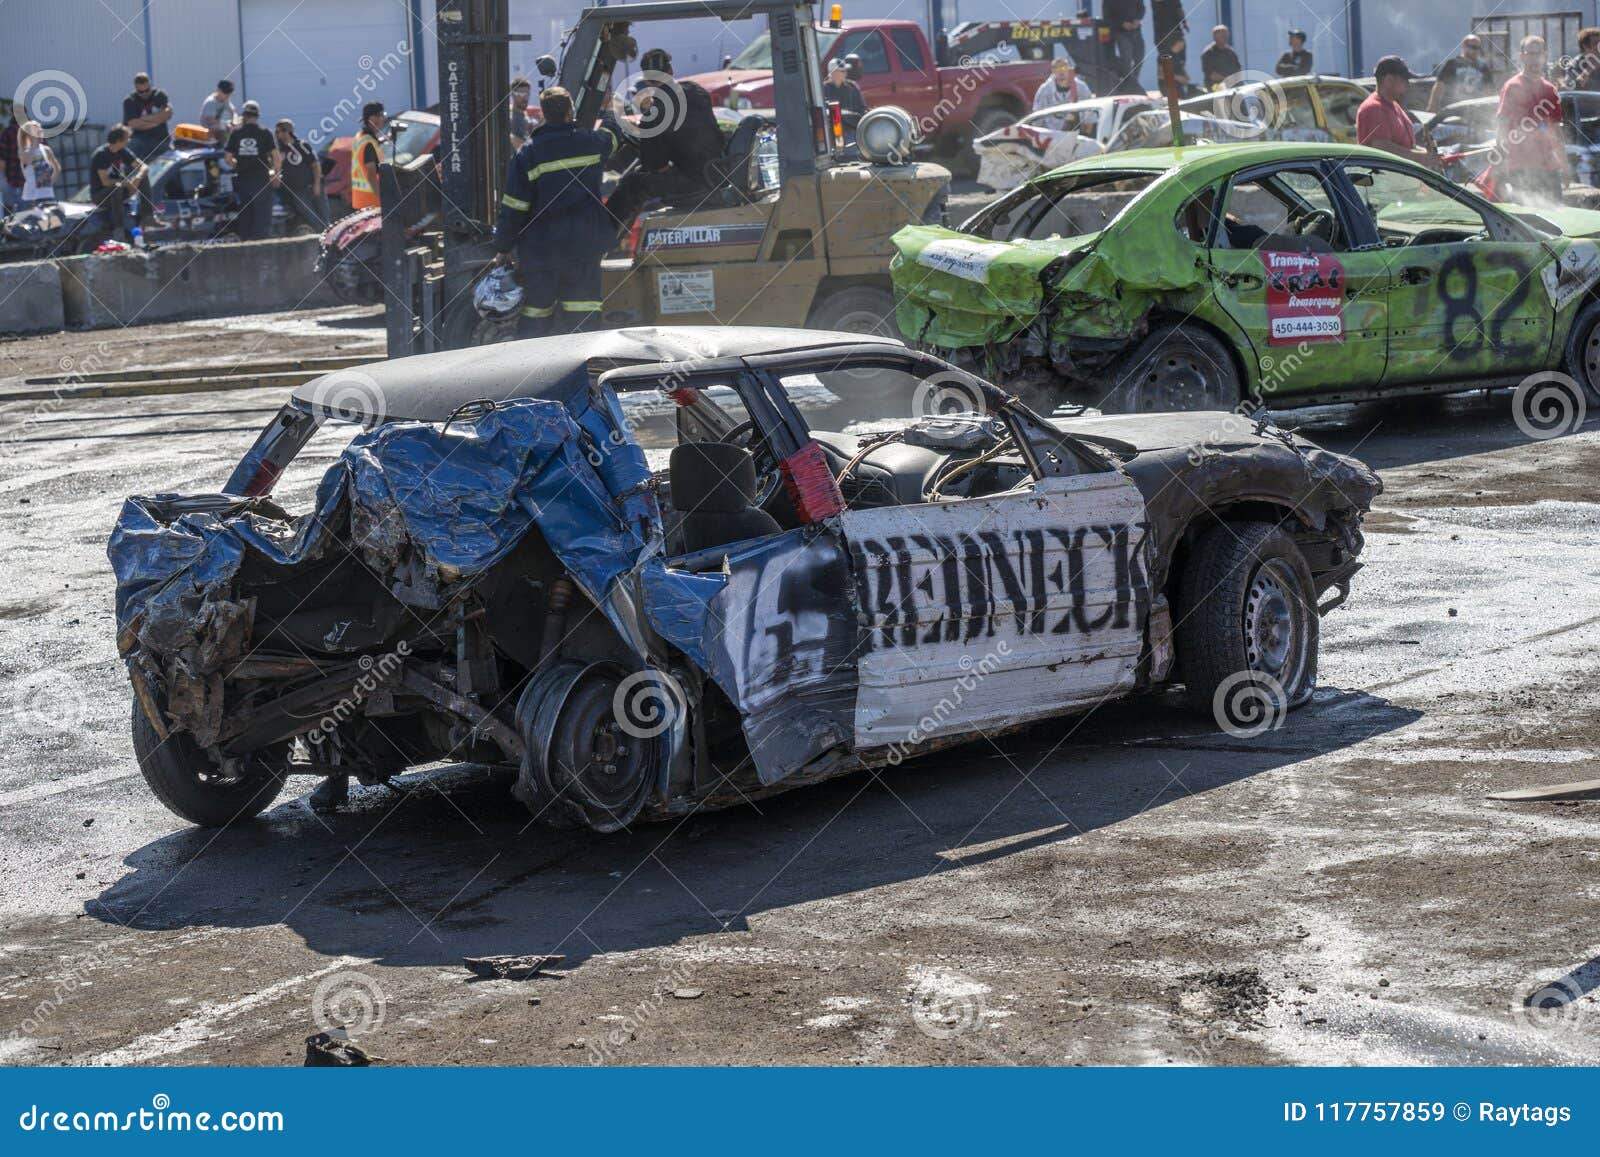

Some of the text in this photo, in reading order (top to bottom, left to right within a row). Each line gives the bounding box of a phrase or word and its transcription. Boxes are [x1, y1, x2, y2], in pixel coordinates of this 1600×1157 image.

[448, 62, 461, 173] CATERPILLAR
[646, 229, 721, 247] CATERPILLAR
[1268, 253, 1320, 270] Transport
[1275, 321, 1340, 334] 450-444-3050
[1437, 250, 1549, 360] 82
[851, 523, 1150, 656] REDNECK
